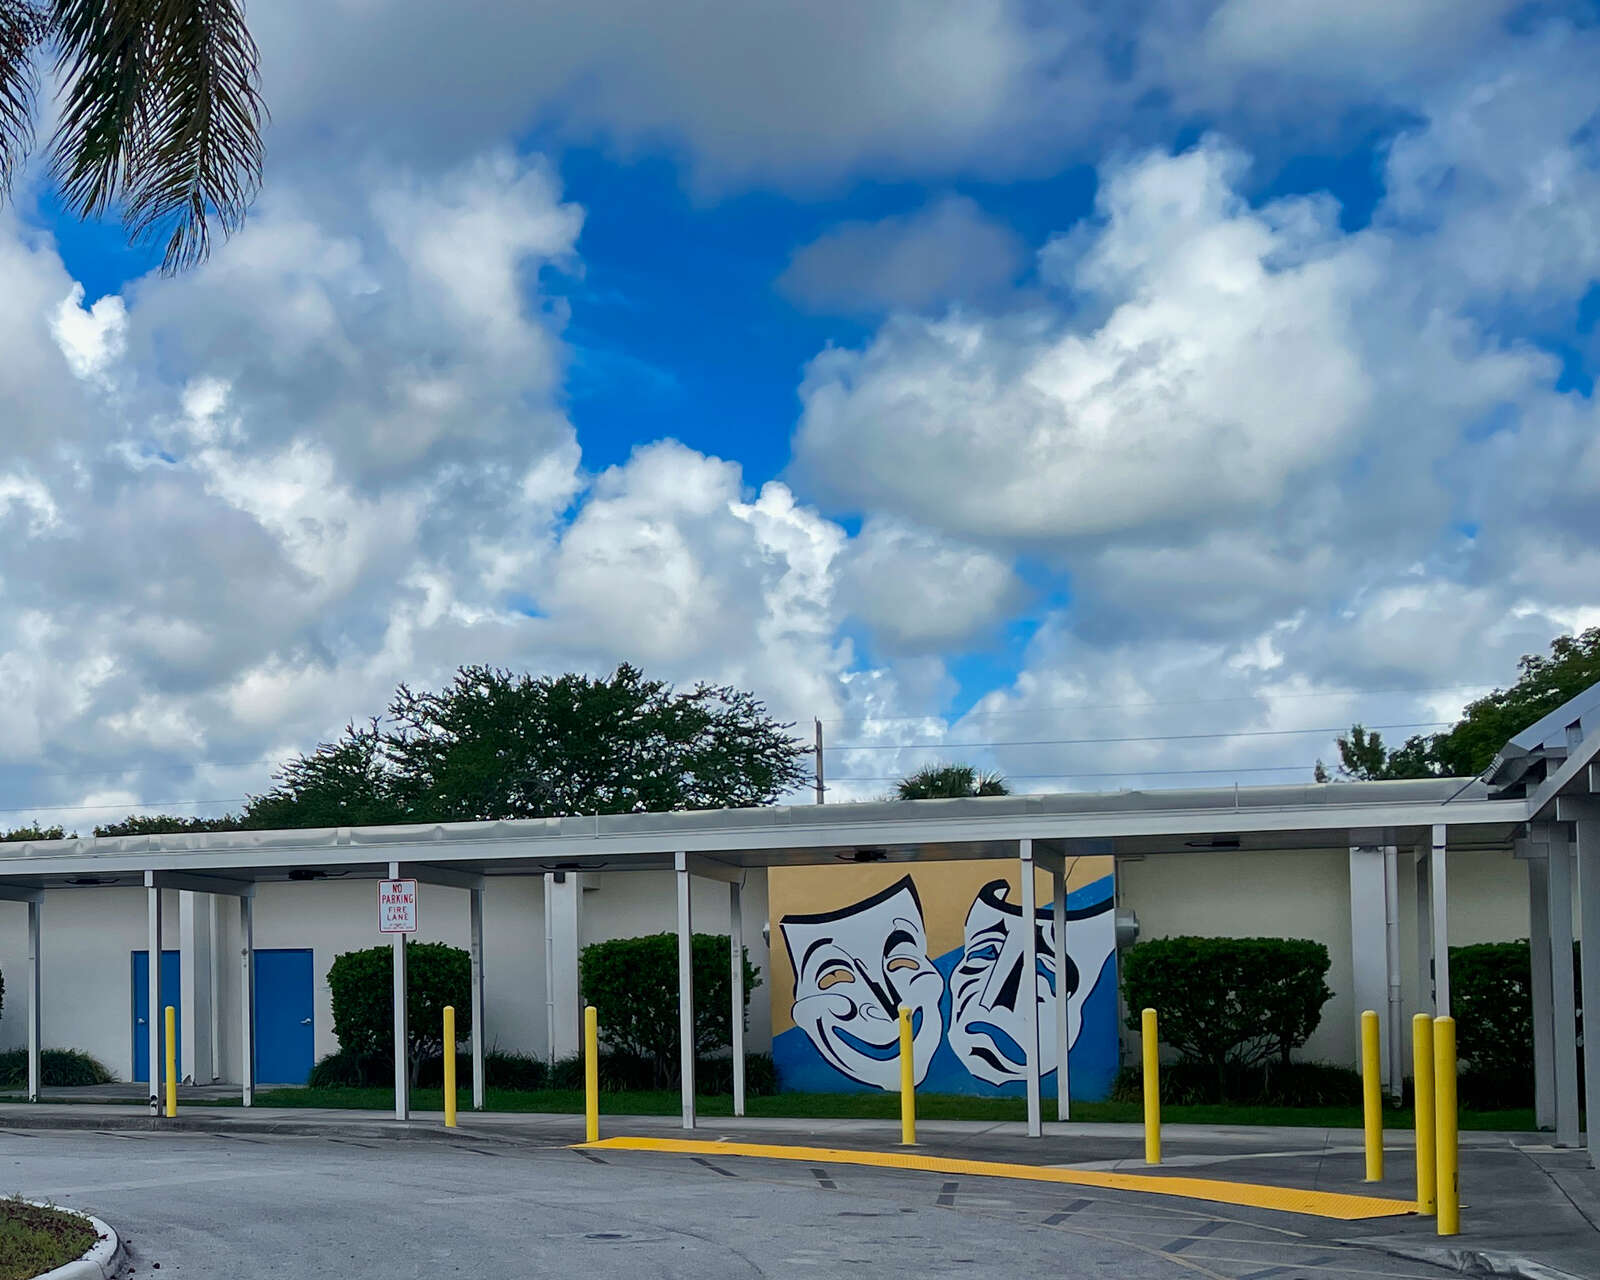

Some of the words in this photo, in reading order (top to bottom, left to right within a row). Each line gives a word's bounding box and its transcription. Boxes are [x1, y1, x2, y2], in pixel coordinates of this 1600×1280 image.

[392, 883, 403, 893] NO
[381, 894, 414, 904] PARKING
[386, 913, 409, 921] LANE
